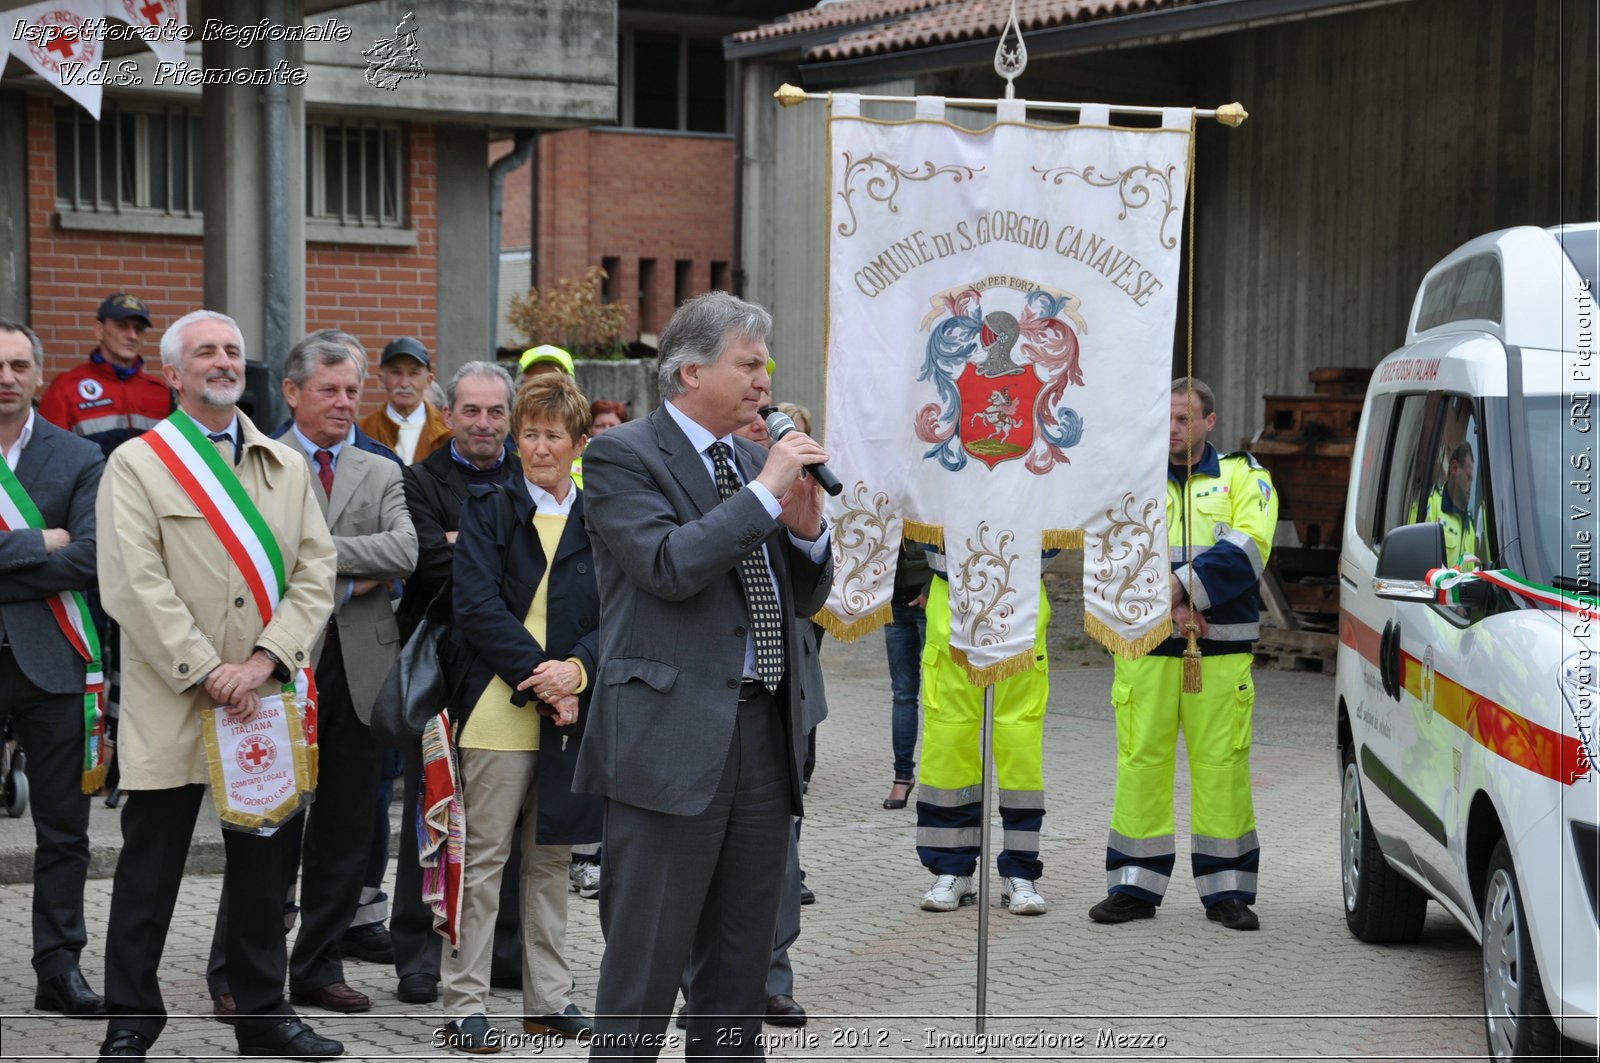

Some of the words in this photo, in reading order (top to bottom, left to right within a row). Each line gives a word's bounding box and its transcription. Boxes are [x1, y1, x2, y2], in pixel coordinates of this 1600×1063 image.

[854, 230, 935, 298] COMUNE
[931, 232, 957, 258] DI
[1055, 225, 1164, 308] CANAVESE
[988, 275, 1007, 287] PER
[255, 709, 279, 721] OSSA
[231, 720, 273, 736] ITALIANA
[231, 776, 262, 789] COMITATO
[263, 770, 287, 782] LOCALE
[256, 783, 264, 792] DI
[230, 790, 244, 802] SAN
[244, 795, 274, 806] GIORGIO
